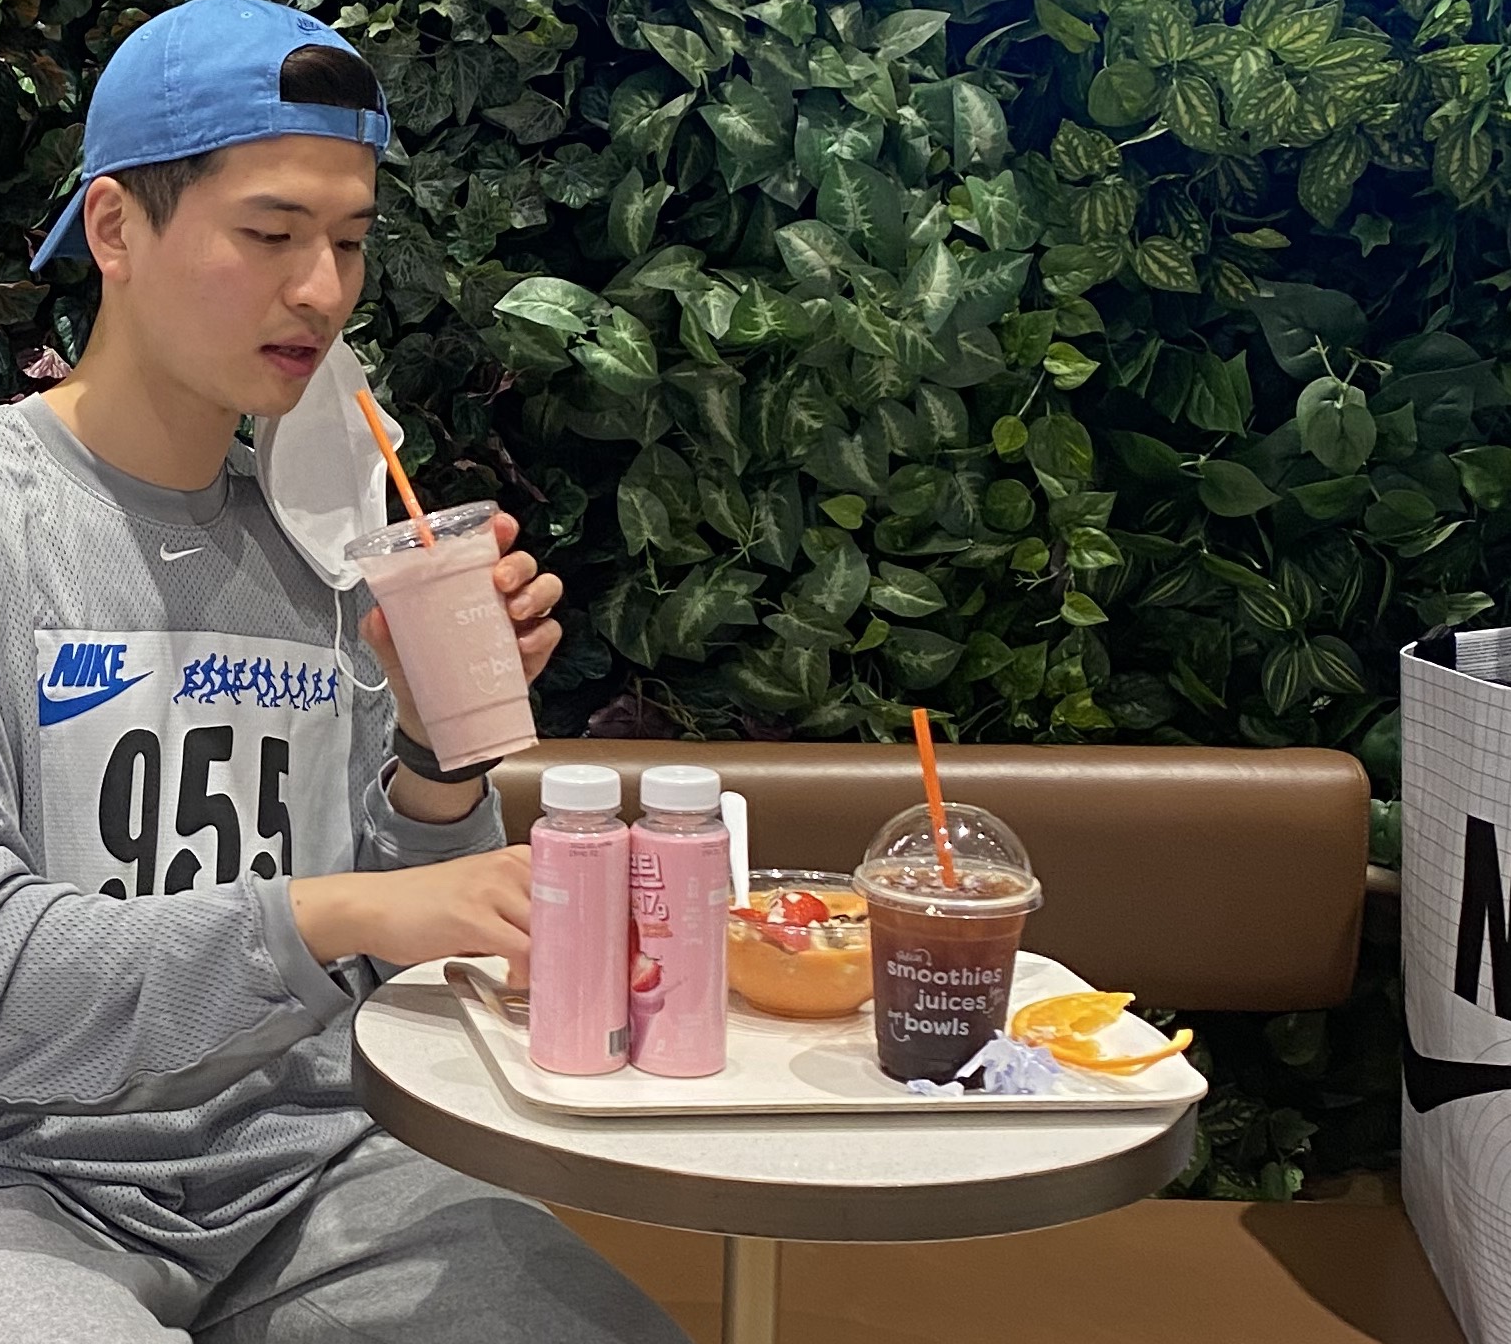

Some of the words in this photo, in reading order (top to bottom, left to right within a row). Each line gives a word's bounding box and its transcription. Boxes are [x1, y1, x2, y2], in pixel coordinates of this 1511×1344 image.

[47, 643, 128, 687] NIKE
[99, 725, 293, 899] 955
[887, 960, 1003, 986] smoothies
[914, 989, 987, 1011] juices
[904, 1012, 970, 1036] bowls
